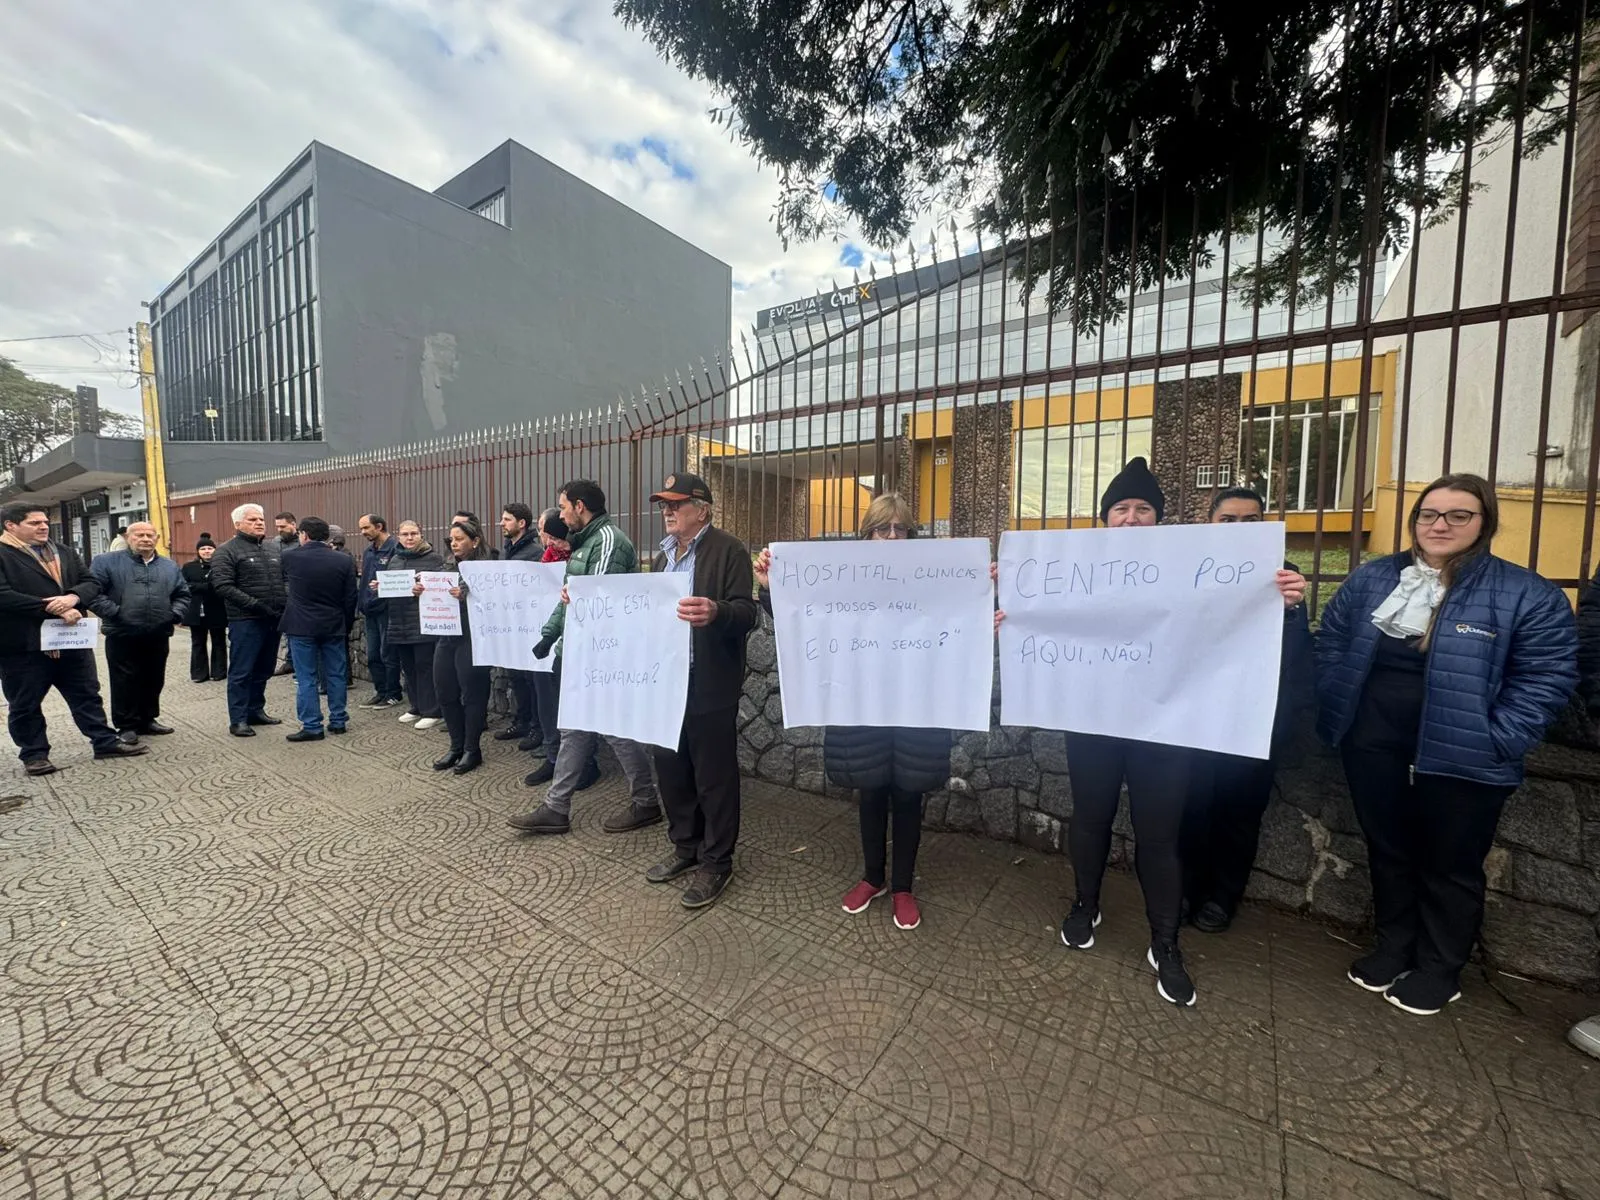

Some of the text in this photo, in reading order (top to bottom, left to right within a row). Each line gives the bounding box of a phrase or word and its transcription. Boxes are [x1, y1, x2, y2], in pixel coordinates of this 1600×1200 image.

[782, 561, 977, 588] HOSPITAL, CLINICAS
[1016, 557, 1255, 598] CENTRO POP
[503, 600, 522, 611] VIVE
[530, 600, 538, 608] E
[574, 596, 614, 622] ONDE
[806, 603, 813, 616] E
[806, 638, 818, 660] E
[830, 638, 838, 653] O
[851, 639, 879, 651] BOM
[1102, 640, 1153, 665] NÃO!
